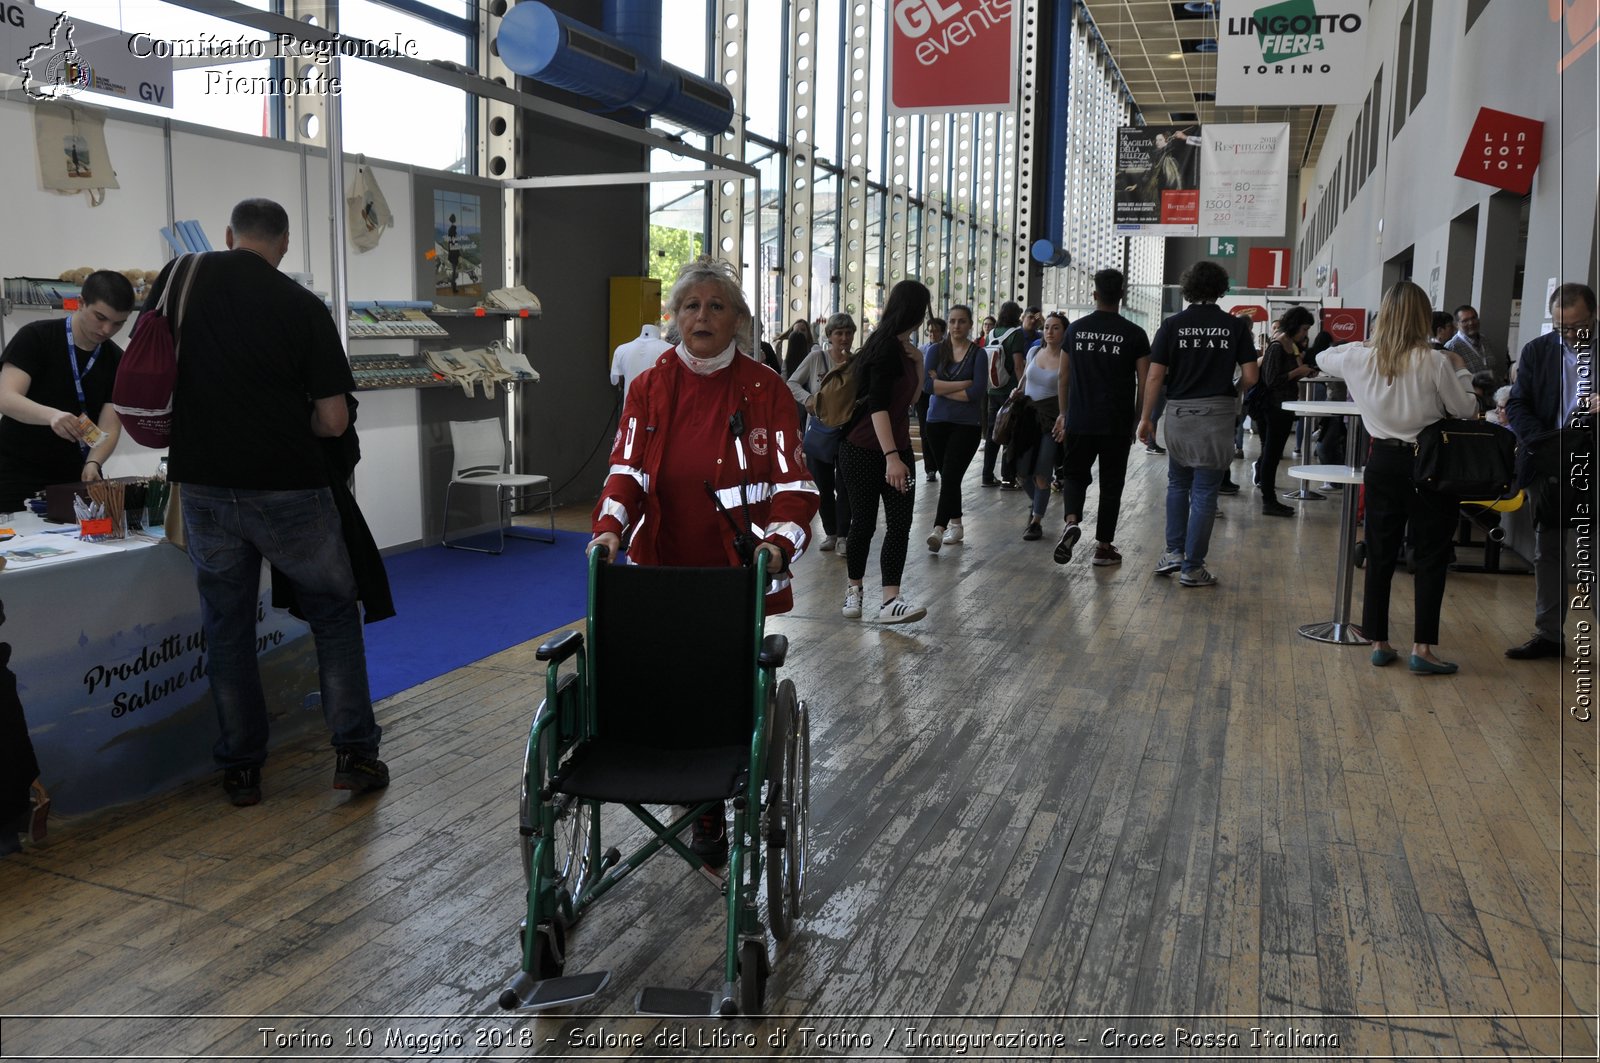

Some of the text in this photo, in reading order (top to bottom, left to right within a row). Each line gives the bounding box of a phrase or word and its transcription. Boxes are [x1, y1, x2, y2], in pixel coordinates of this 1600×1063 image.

[895, 0, 963, 38] GL
[1228, 13, 1362, 35] LINGOTTO
[915, 0, 1011, 65] events
[1262, 33, 1323, 54] FIERE
[1243, 64, 1331, 75] TORINO
[139, 82, 165, 103] GV
[1119, 138, 1153, 147] FRAGILITÀ
[1119, 152, 1150, 160] BELLEZZA
[1484, 146, 1525, 156] GOT
[1234, 182, 1251, 191] 80
[1205, 200, 1232, 209] 1300
[1234, 194, 1255, 204] 212
[1214, 213, 1231, 221] 230
[1266, 250, 1287, 288] 1
[1075, 331, 1124, 343] SERVIZIO
[1178, 327, 1230, 337] SERVIZIO
[1075, 341, 1121, 355] REAR
[1179, 339, 1229, 349] REAR
[83, 633, 185, 695] Prodotti
[111, 676, 188, 719] Salone
